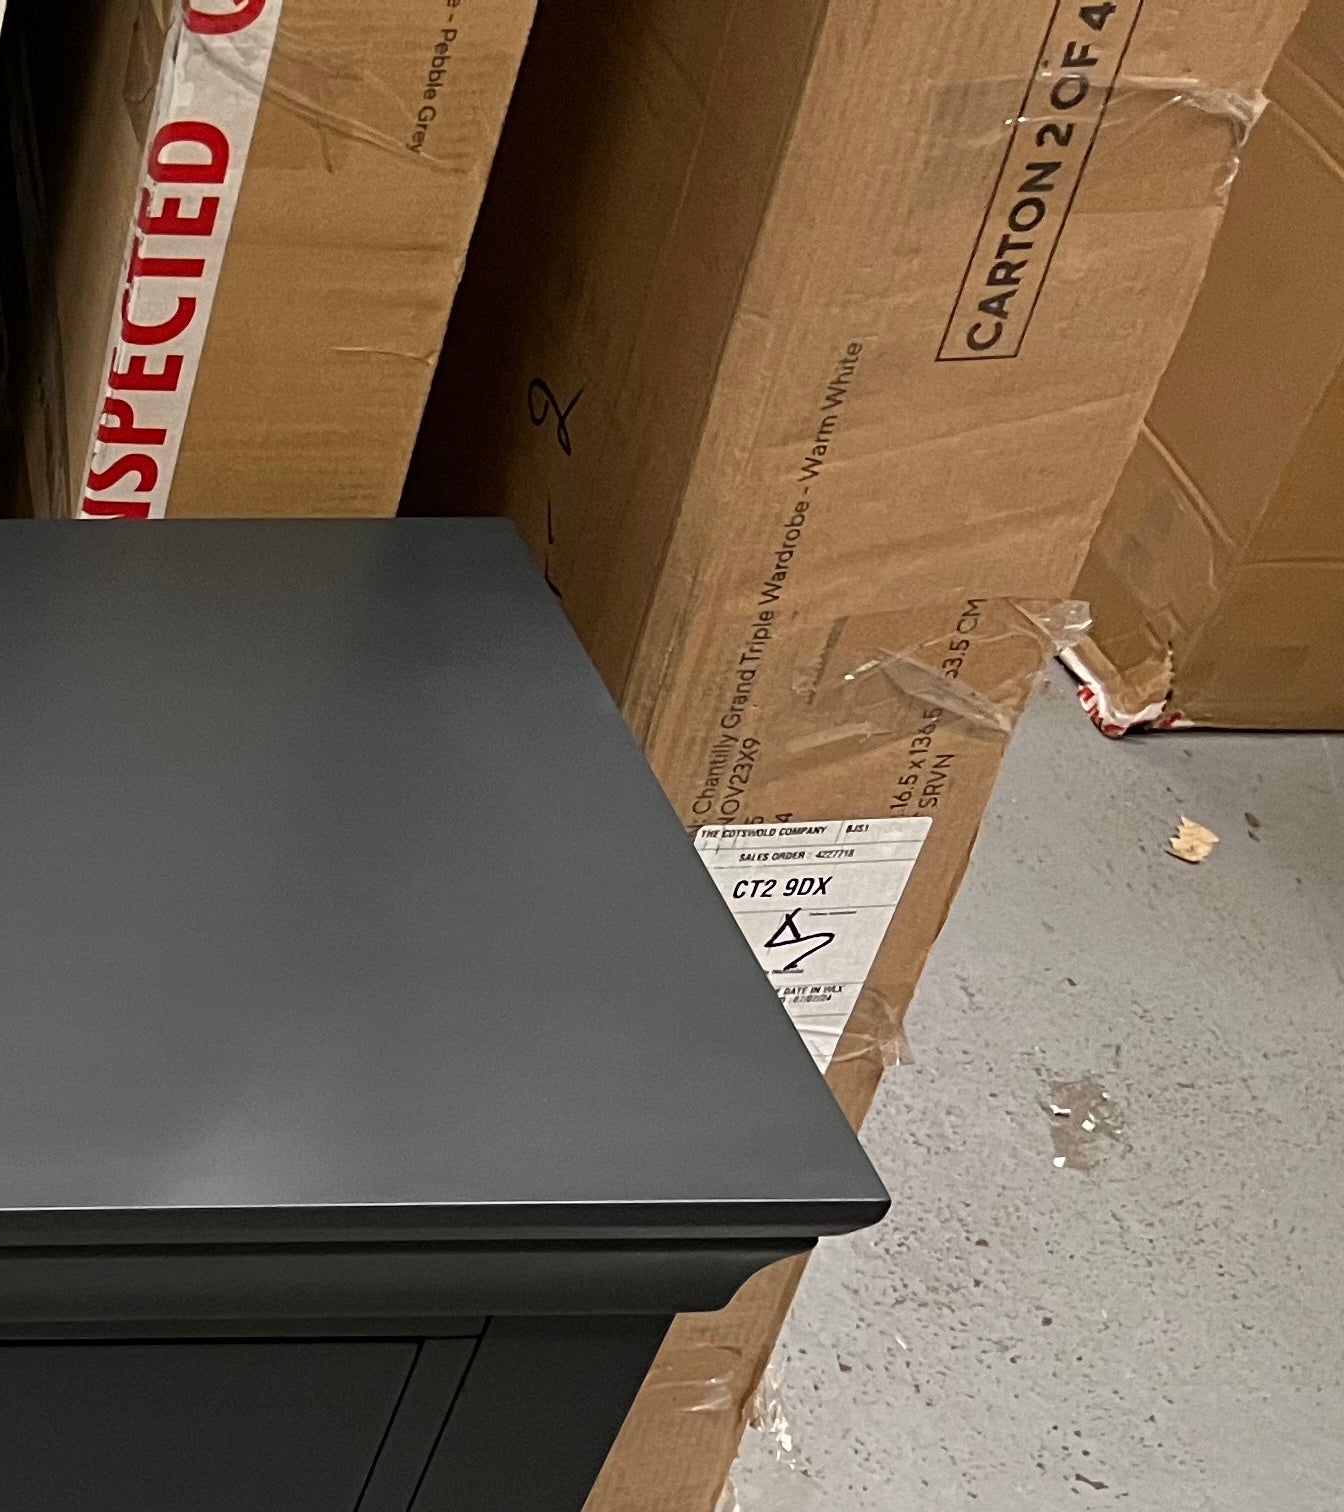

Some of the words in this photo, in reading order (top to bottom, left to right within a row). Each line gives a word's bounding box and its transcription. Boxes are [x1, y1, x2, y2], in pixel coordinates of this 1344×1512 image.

[1079, 1, 1116, 31] 4
[423, 28, 458, 100] Pebble
[1050, 41, 1099, 110] OF
[406, 105, 437, 155] Grey
[1036, 123, 1075, 147] 2
[966, 161, 1063, 351] CARTON
[692, 733, 739, 814] Chantilly
[720, 668, 756, 729] Grand
[740, 609, 774, 667] Triple
[760, 500, 811, 608] Wardrobe
[800, 415, 838, 482] Warm
[821, 341, 863, 408] White
[956, 597, 989, 635] CM
[918, 753, 956, 809] SRVN
[701, 829, 720, 838] THE
[721, 827, 777, 838] COTSWOLD
[778, 825, 828, 836] COMPANY
[739, 852, 770, 862] SALES
[771, 850, 806, 861] ORDER
[732, 878, 778, 899] CT2
[782, 875, 834, 897] 9DX
